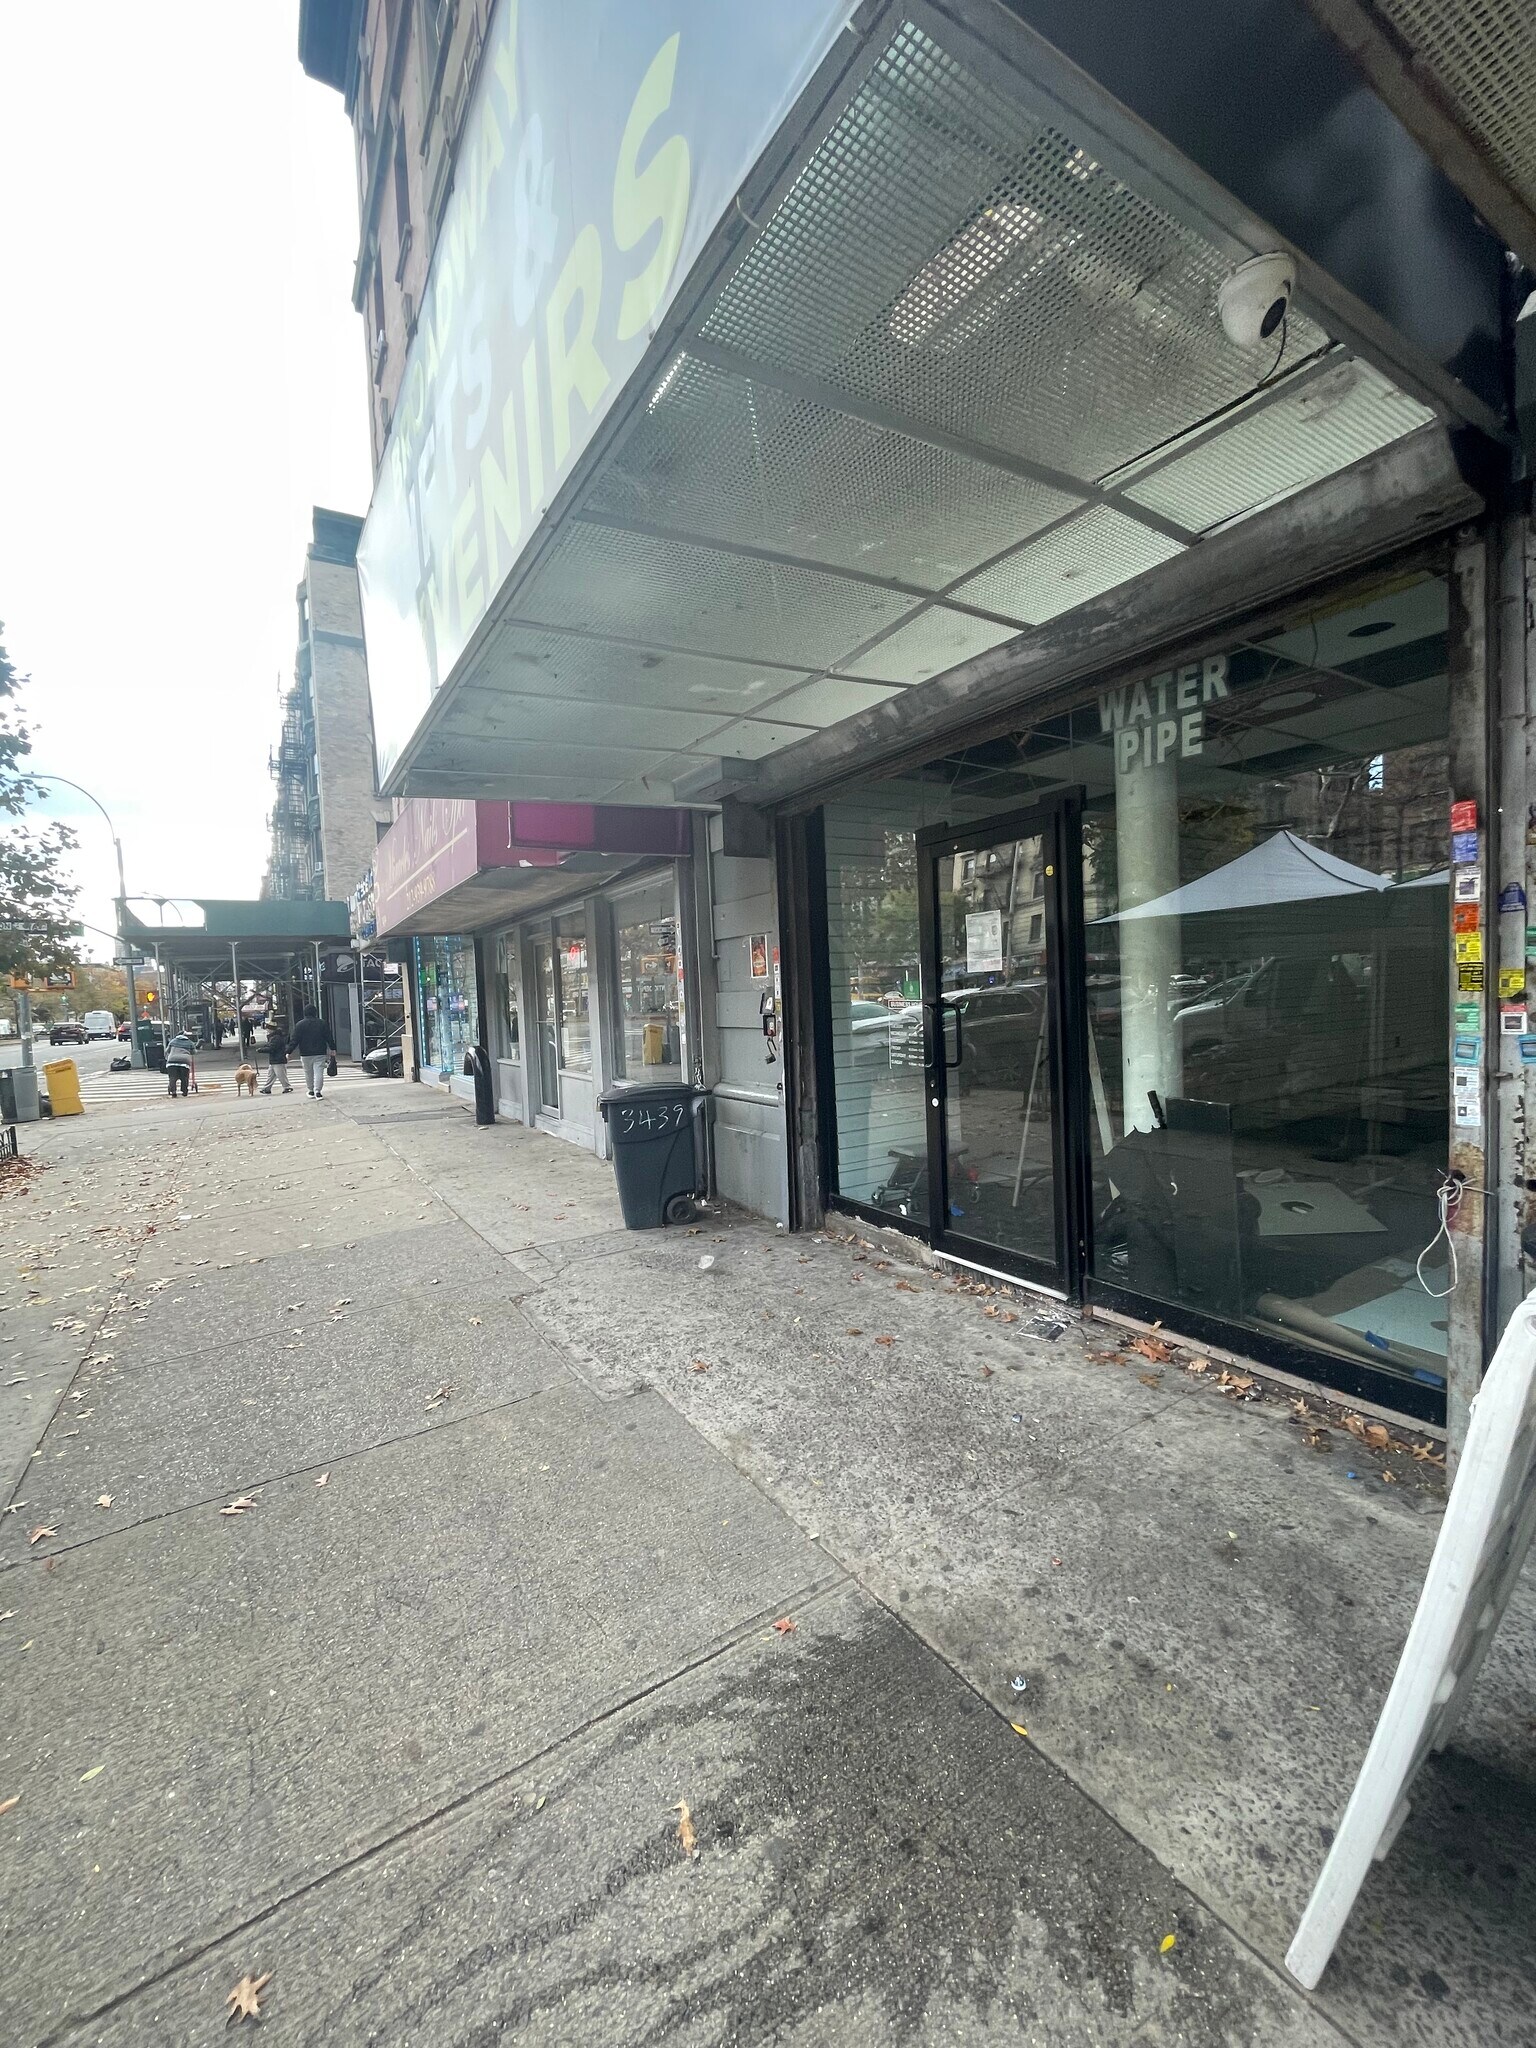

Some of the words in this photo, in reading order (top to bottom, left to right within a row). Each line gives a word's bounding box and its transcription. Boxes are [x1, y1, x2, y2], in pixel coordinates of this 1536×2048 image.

[512, 113, 559, 327] &
[420, 32, 691, 648] VENIRS
[1099, 655, 1228, 732] WATER
[1119, 711, 1203, 774] PIPE
[621, 1104, 684, 1133] 3439
